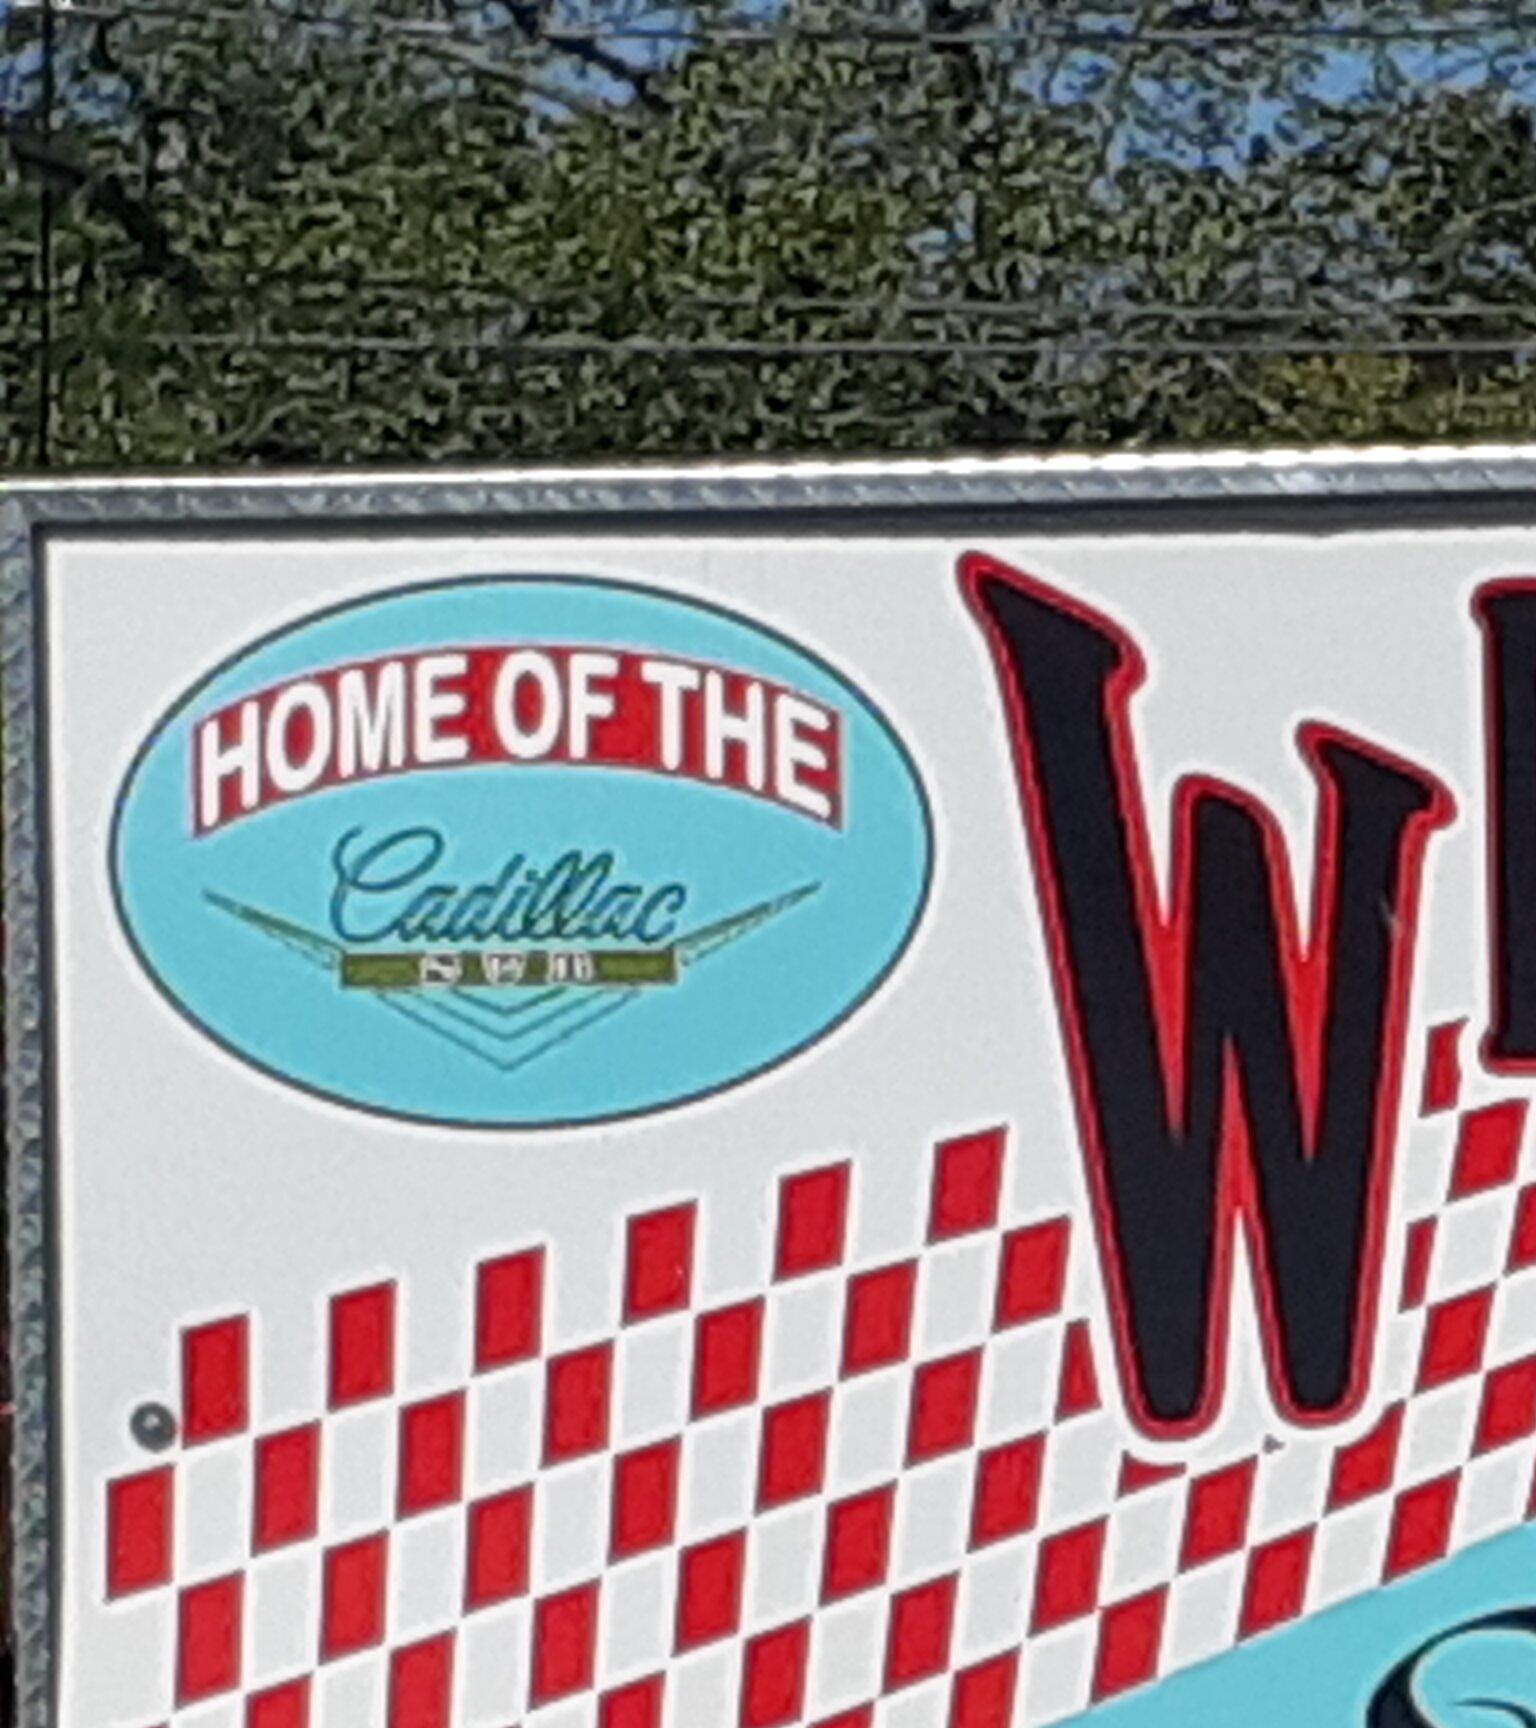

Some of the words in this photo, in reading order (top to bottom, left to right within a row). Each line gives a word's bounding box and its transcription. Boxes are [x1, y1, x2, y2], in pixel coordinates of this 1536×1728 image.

[200, 651, 470, 828] HOME
[492, 649, 618, 761] OF
[641, 660, 831, 819] THE
[329, 825, 688, 945] Cadillac
